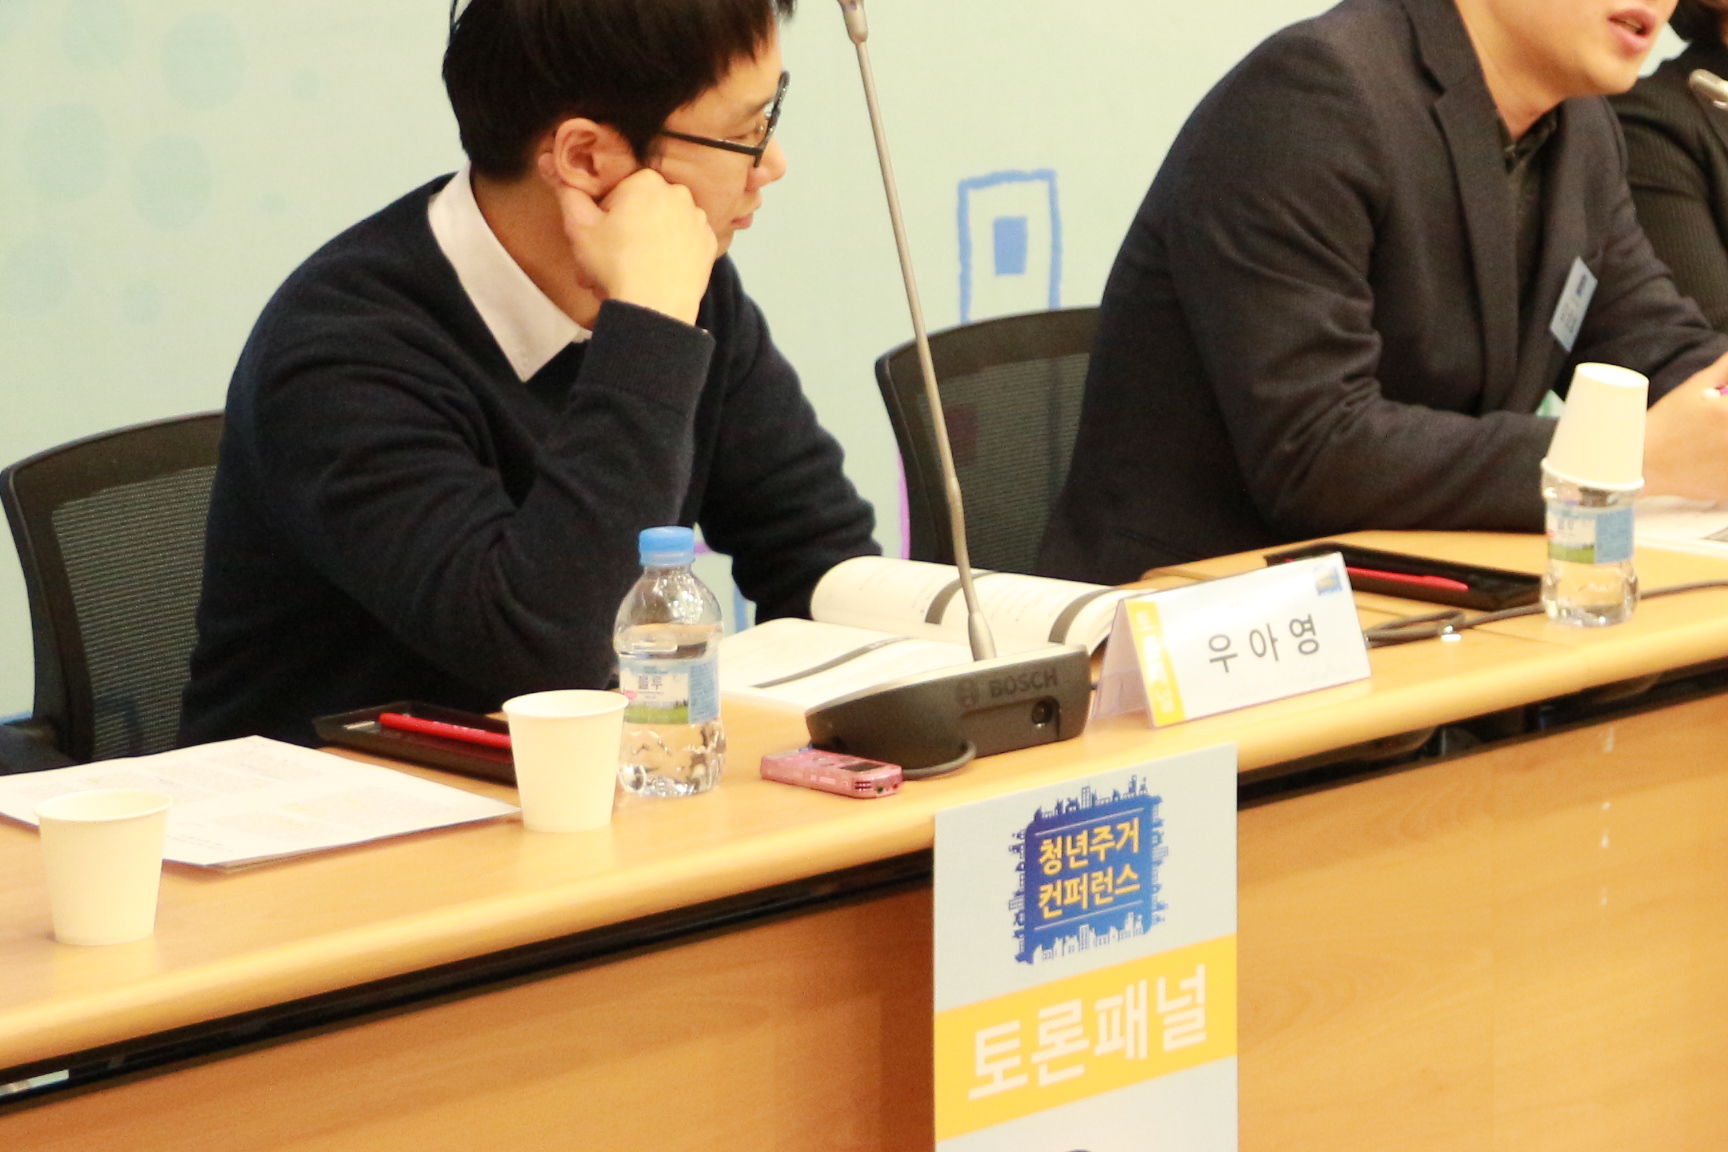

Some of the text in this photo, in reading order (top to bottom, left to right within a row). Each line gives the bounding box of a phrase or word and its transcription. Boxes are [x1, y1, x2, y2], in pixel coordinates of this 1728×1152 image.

[989, 668, 1058, 697] BOSCH
[1038, 817, 1140, 875] 청년주거
[1038, 863, 1142, 919] 컨퍼런스
[968, 963, 1207, 1100] 토론패널
